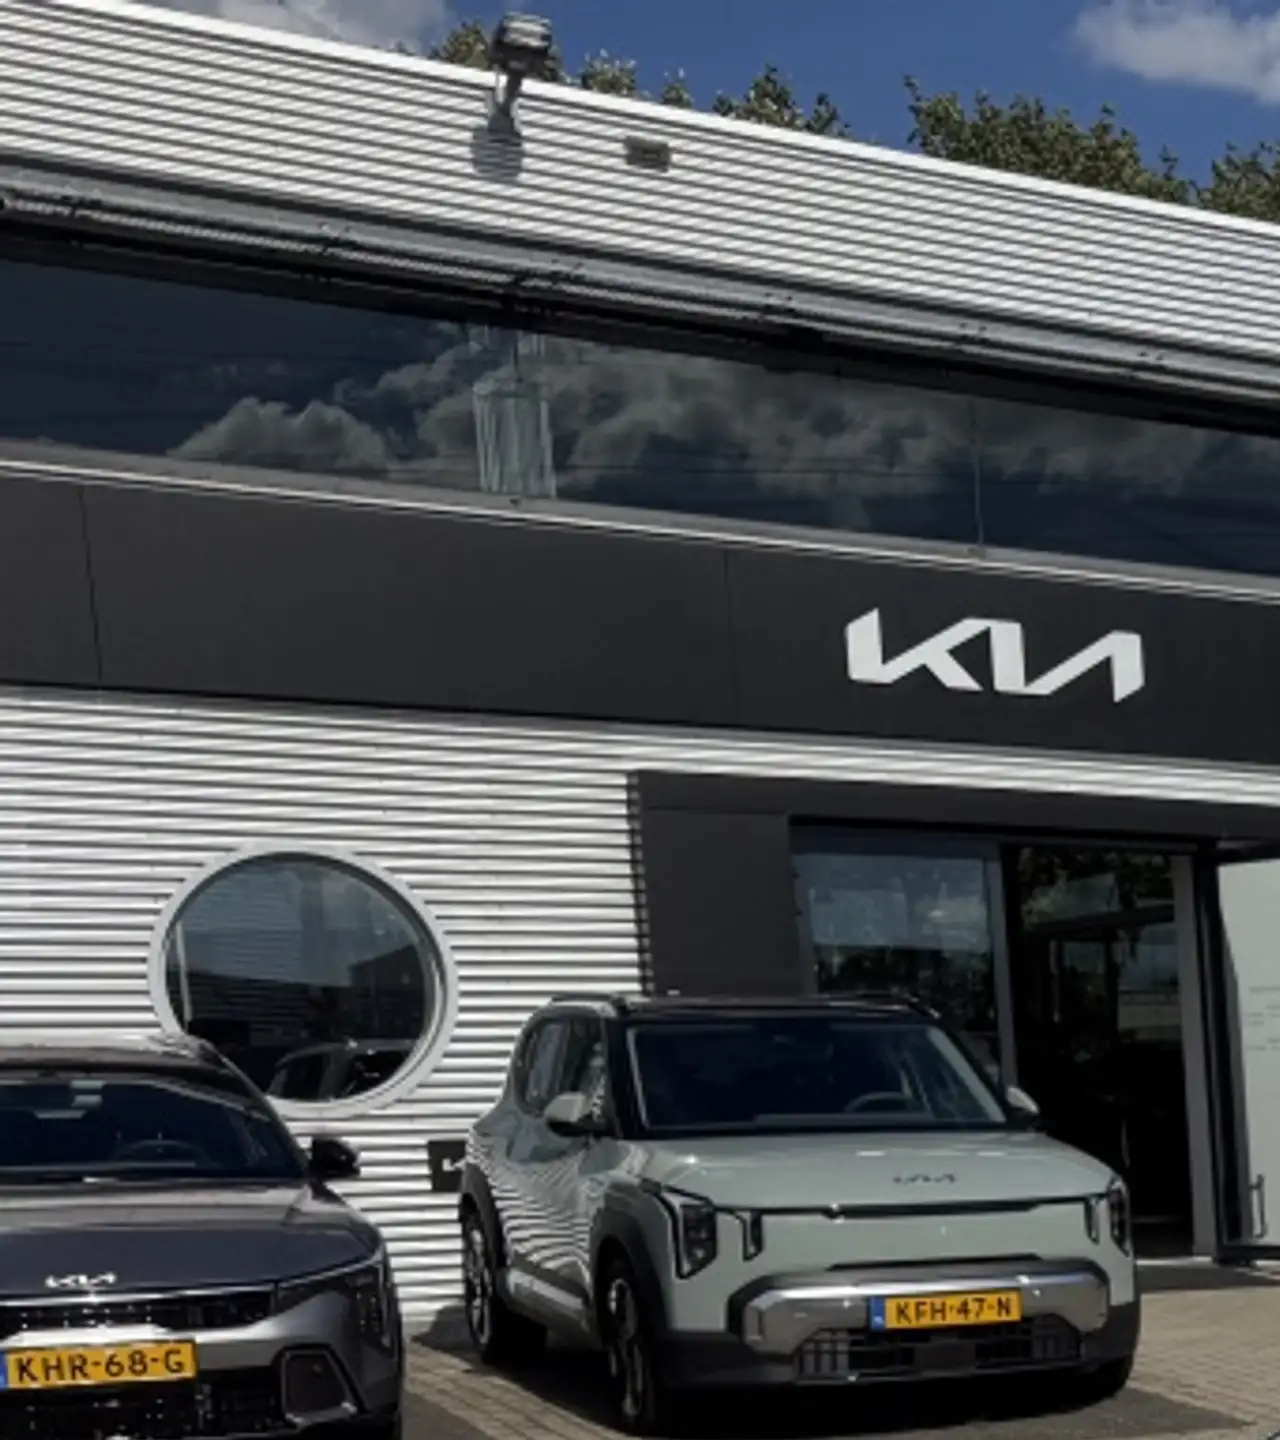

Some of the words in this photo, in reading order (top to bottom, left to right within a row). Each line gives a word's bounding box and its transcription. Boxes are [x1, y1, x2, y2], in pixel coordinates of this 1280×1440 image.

[845, 606, 1145, 703] KIA
[896, 1297, 1012, 1325] KFH-47-N
[16, 1349, 185, 1383] KHR-68-G
